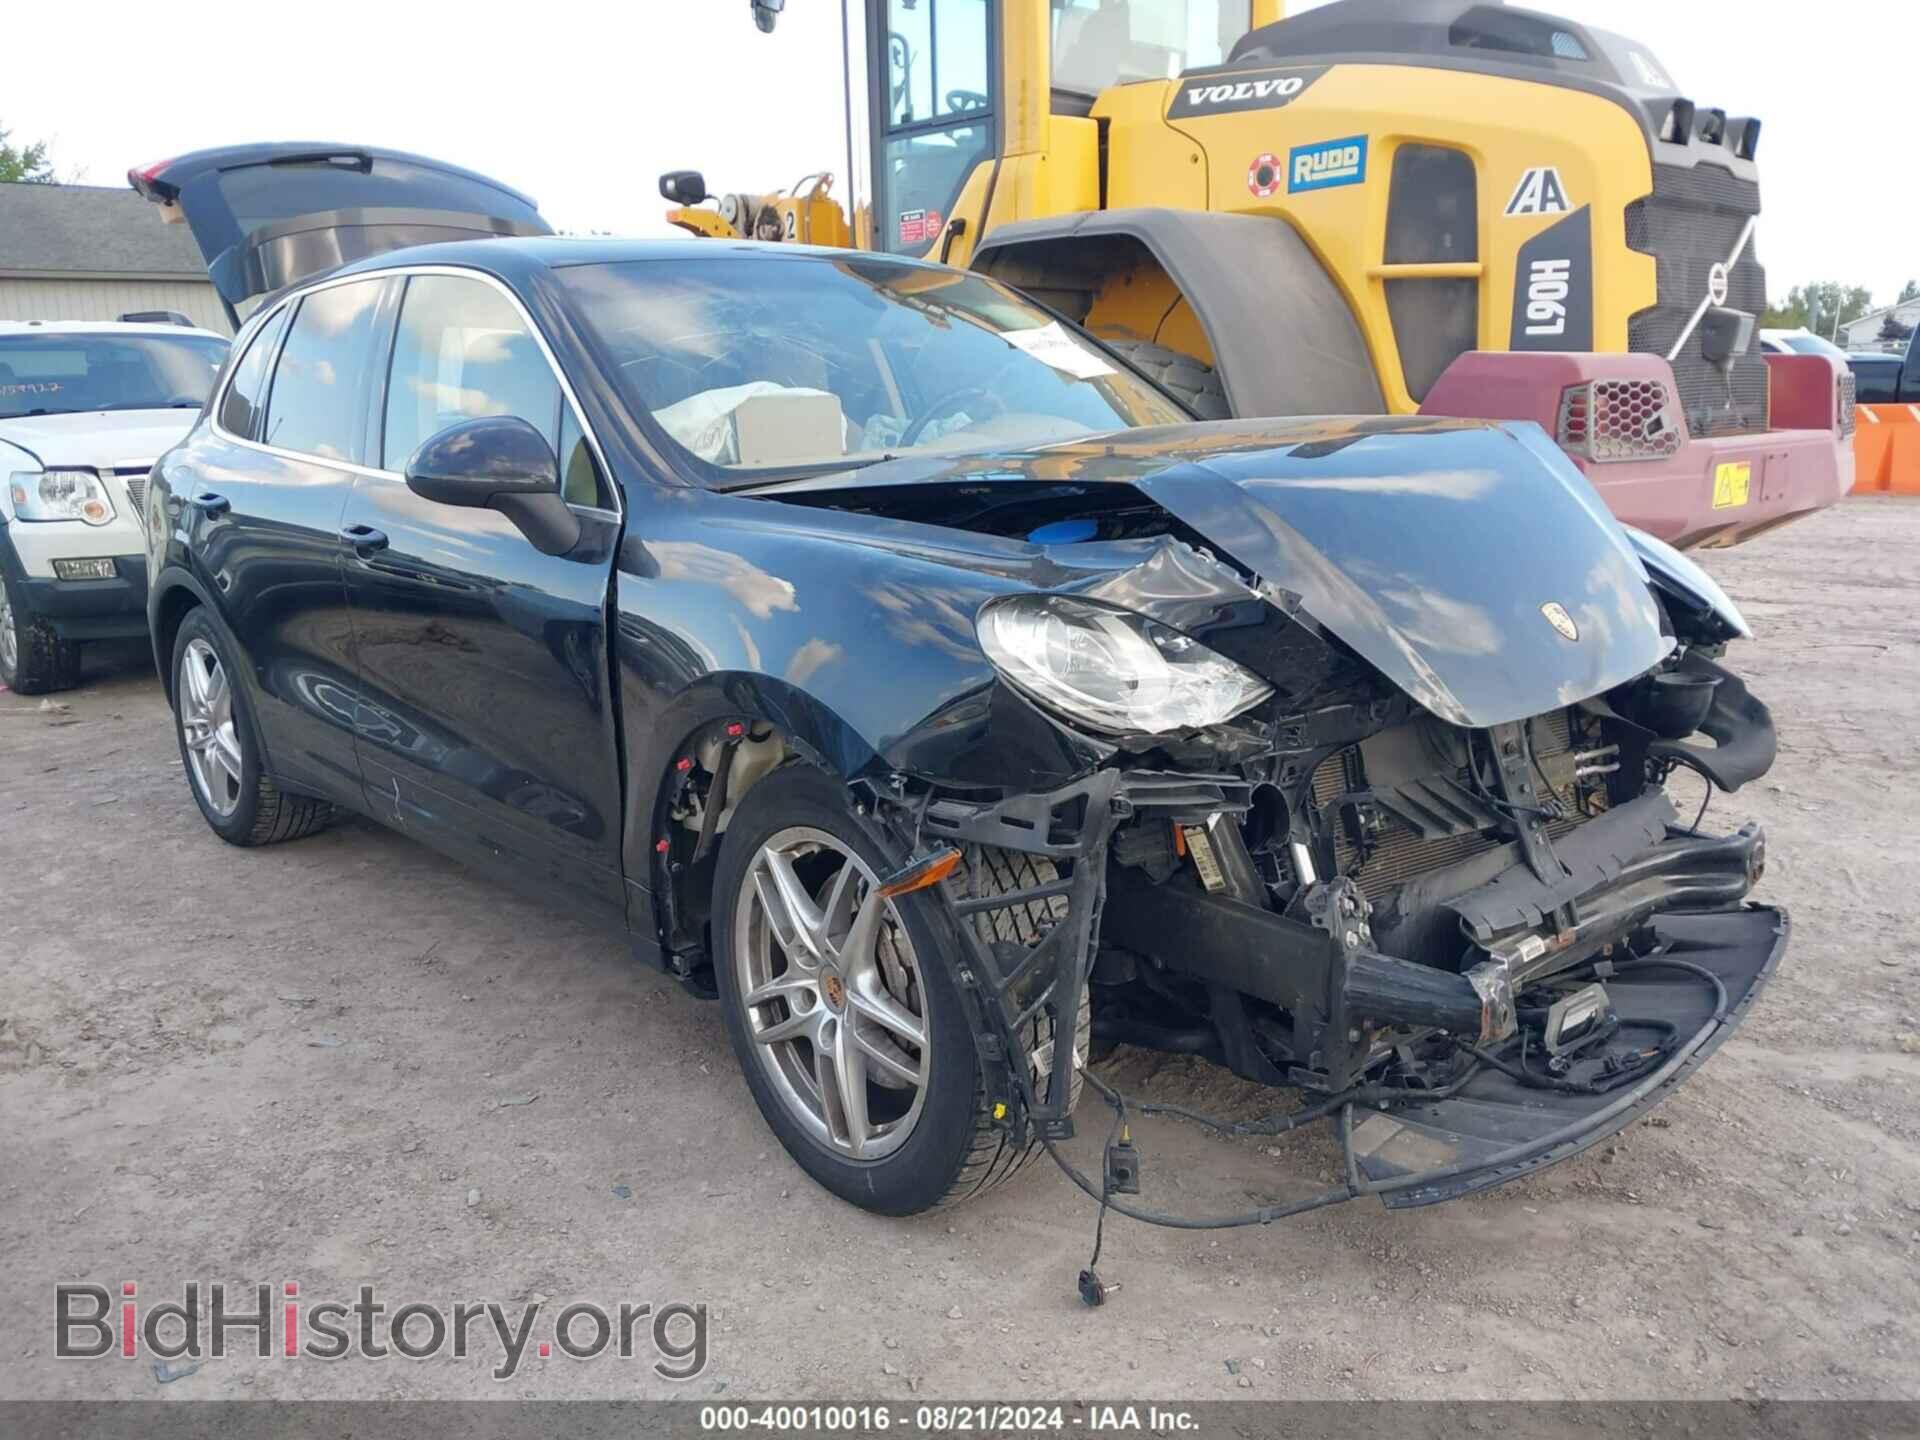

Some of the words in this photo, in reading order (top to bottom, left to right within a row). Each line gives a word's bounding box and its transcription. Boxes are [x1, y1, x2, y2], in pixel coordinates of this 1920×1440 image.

[1187, 77, 1304, 105] VOLVO
[1294, 145, 1360, 184] RUDD
[1524, 259, 1571, 336] L90H
